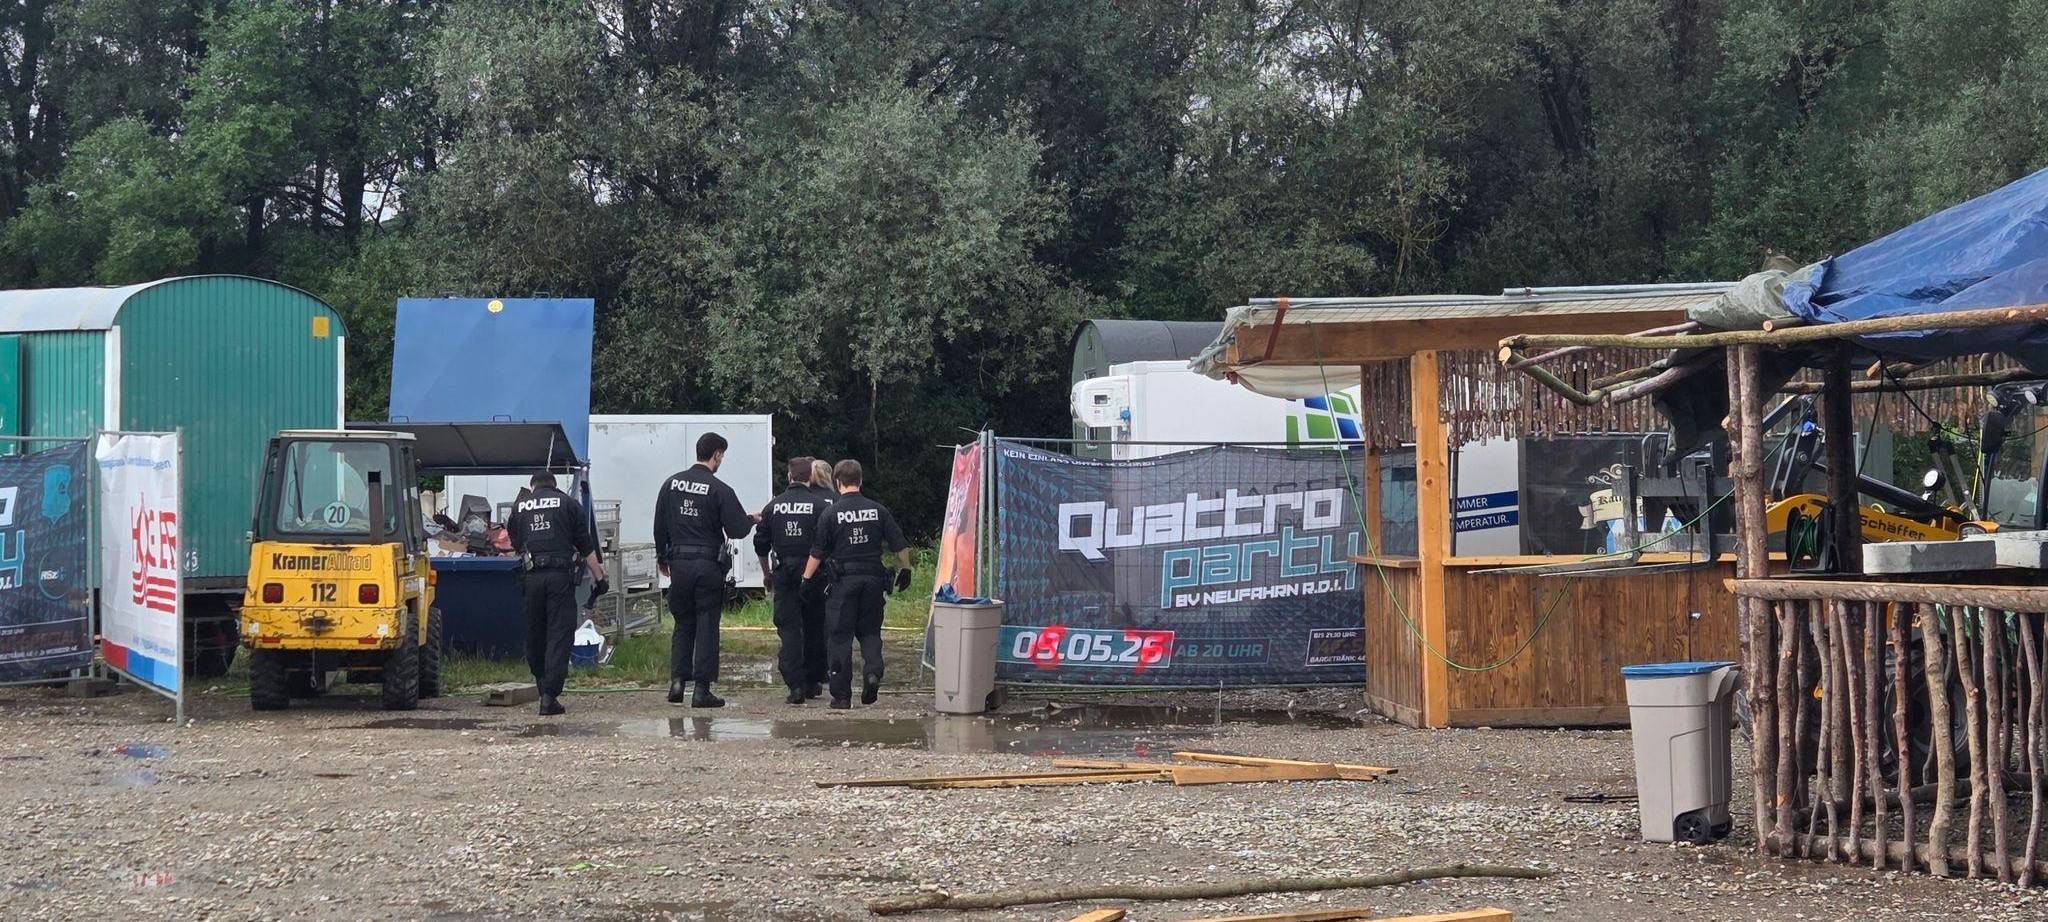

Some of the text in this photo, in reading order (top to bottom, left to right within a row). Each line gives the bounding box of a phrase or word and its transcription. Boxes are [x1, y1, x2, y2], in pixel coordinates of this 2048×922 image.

[671, 479, 710, 495] POLIZEI
[518, 497, 560, 512] POLIZEI
[684, 499, 694, 507] BY
[773, 502, 814, 514] POLIZEI
[1456, 497, 1488, 510] MMER
[328, 505, 345, 523] 20
[534, 513, 545, 522] BY
[680, 506, 699, 517] 1223
[837, 509, 879, 524] POLIZEI
[530, 521, 551, 531] 1223
[787, 521, 799, 530] BY
[1058, 487, 1344, 560] Quattro
[1456, 514, 1510, 530] MPERATUR.
[1860, 515, 1926, 541] Schäffer
[785, 528, 802, 536] 1223
[853, 527, 864, 536] BY
[849, 535, 869, 544] 1223
[1160, 527, 1359, 609] party
[311, 583, 337, 602] 112
[1175, 579, 1342, 608] BV NEUFAHRN R.D.I.
[1175, 643, 1264, 658] AB 20 UHR
